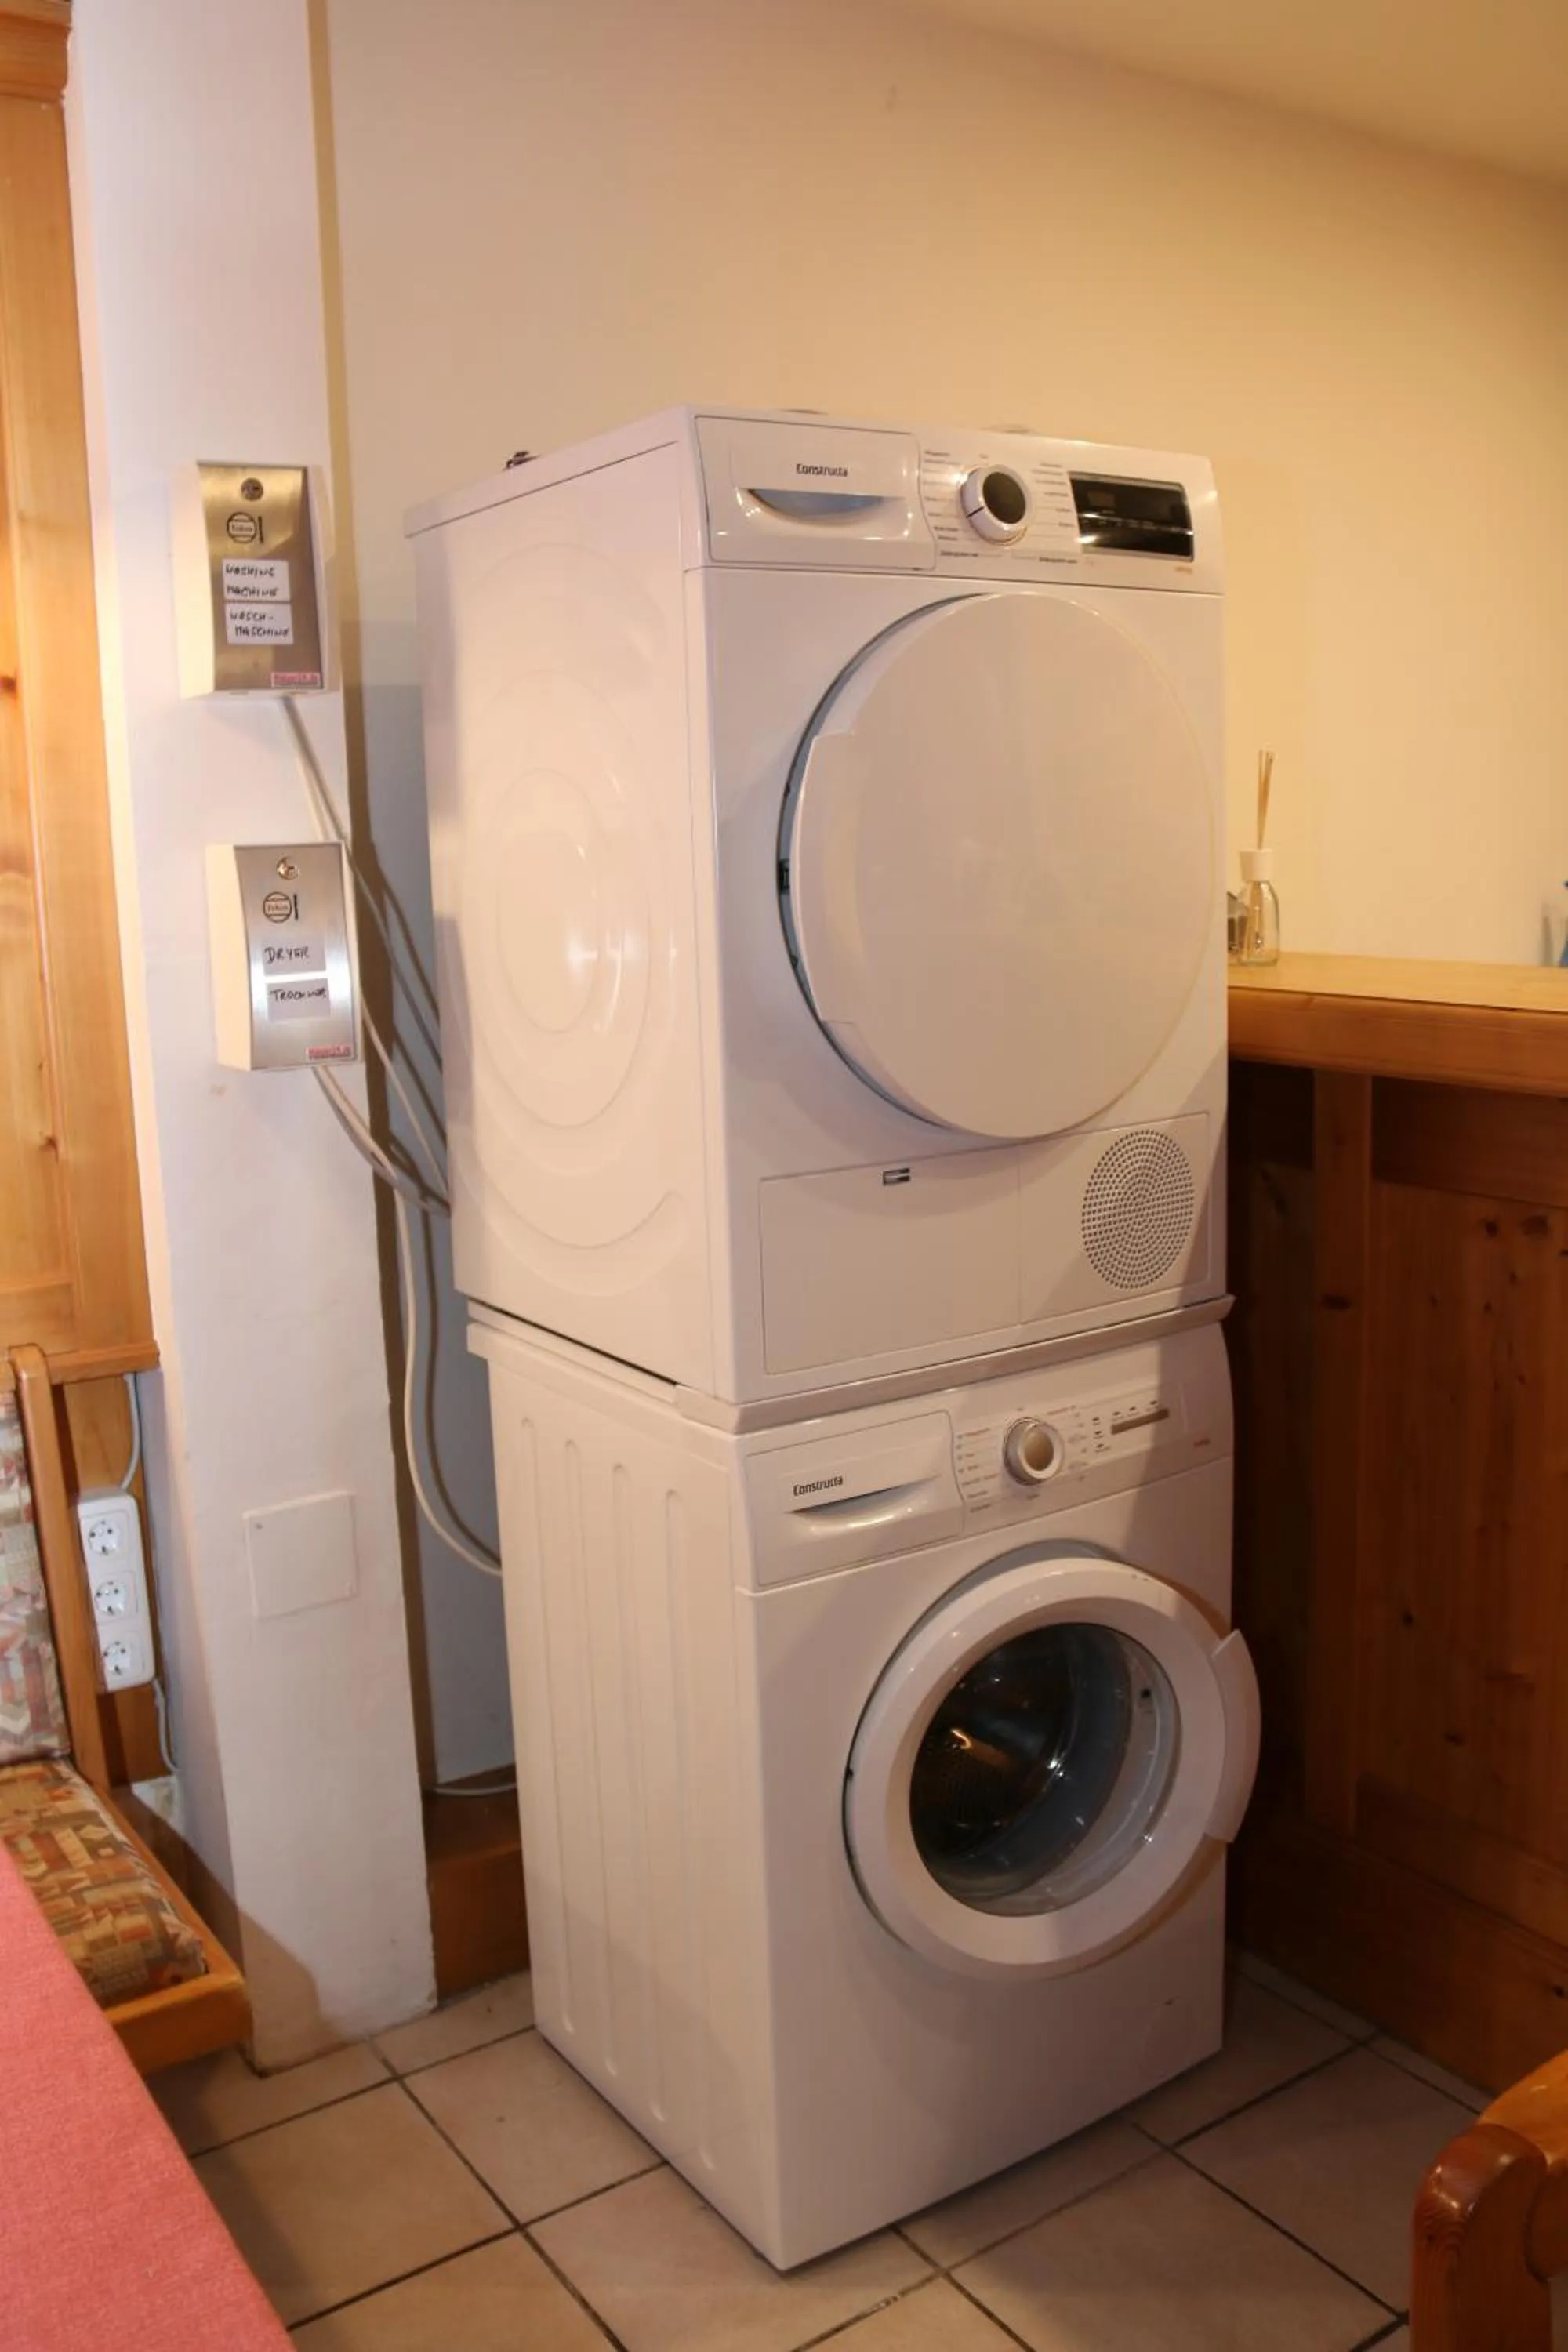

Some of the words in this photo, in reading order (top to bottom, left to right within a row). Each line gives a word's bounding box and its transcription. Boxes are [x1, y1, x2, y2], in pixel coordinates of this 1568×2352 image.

[795, 463, 848, 477] Constructa
[264, 946, 310, 964] DRYER
[793, 1475, 844, 1497] Constructa
